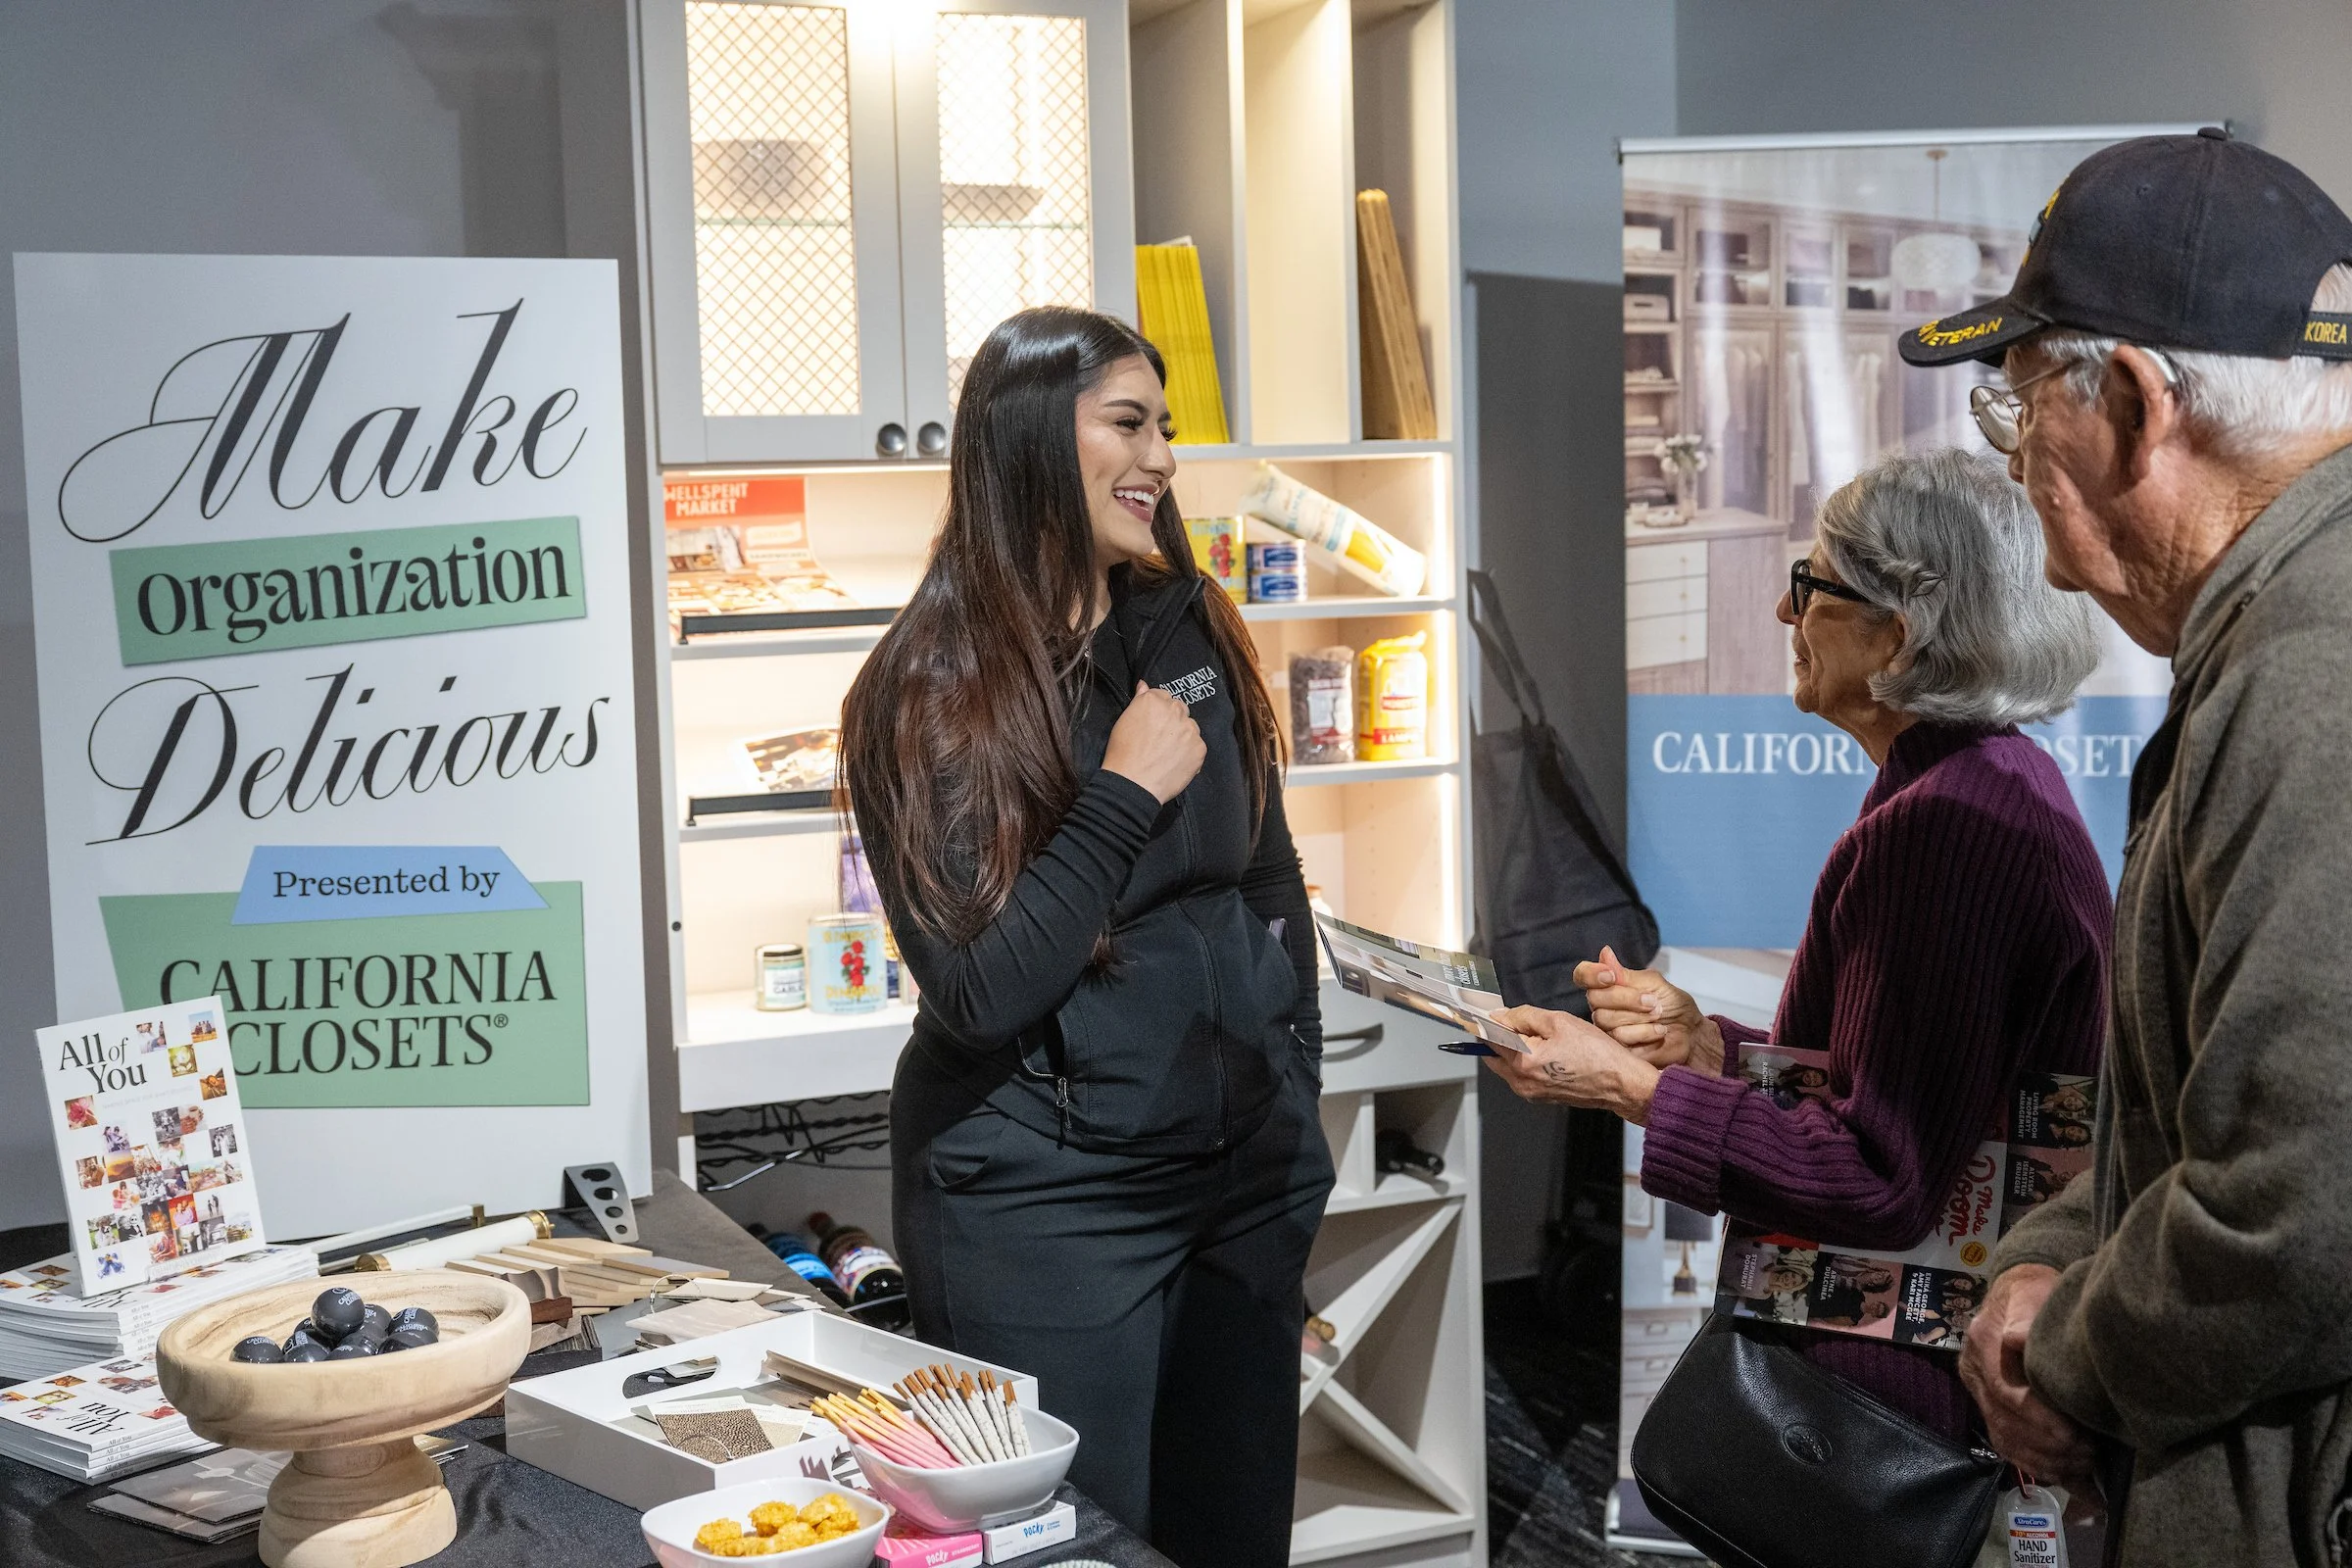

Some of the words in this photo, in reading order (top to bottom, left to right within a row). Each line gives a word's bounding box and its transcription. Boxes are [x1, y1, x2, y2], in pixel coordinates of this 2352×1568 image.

[2304, 321, 2347, 344] KOREA
[59, 298, 588, 543] Make
[664, 482, 748, 502] WELLSPENT
[675, 498, 737, 516] MARKET
[85, 663, 610, 845] Delicious
[273, 869, 454, 898] Presented
[461, 865, 500, 897] by
[160, 950, 558, 1012] CALIFORNIA
[59, 1032, 107, 1071] All
[109, 1037, 128, 1065] of
[86, 1063, 148, 1094] You
[2020, 1160, 2029, 1197] ISENSTEIN
[1972, 1186, 1992, 1236] Make
[1740, 1254, 1750, 1289] DOMURAT
[1746, 1253, 1757, 1291] STEPHANIE
[1820, 1265, 1831, 1300] DULCINEA
[1828, 1269, 1837, 1293] ARYNE
[1916, 1272, 1925, 1288] AMY
[1923, 1272, 1932, 1293] ERIKA
[2014, 1550, 2056, 1564] Sanitizer
[2019, 1539, 2047, 1552] HAND
